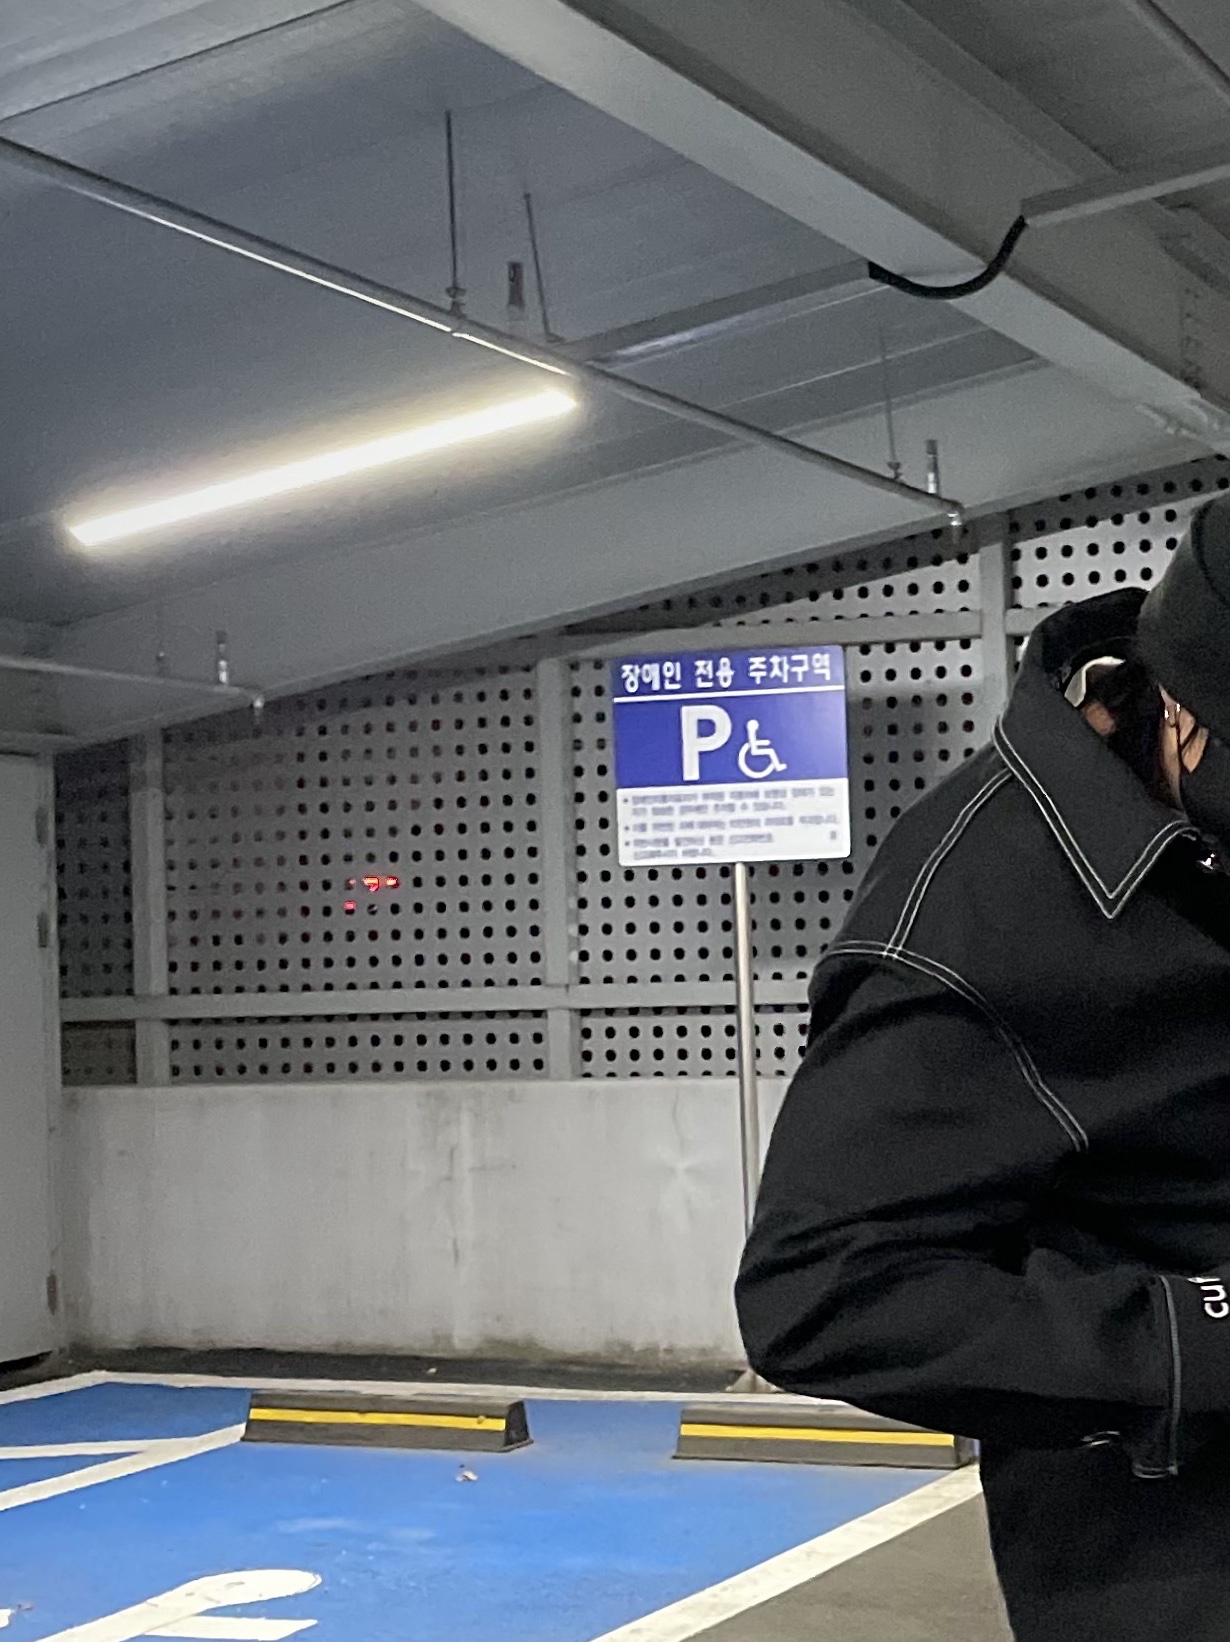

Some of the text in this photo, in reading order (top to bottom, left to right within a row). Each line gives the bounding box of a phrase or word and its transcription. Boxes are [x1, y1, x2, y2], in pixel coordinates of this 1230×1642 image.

[621, 653, 831, 693] 장애인 전용 주차구역
[680, 704, 732, 781] P
